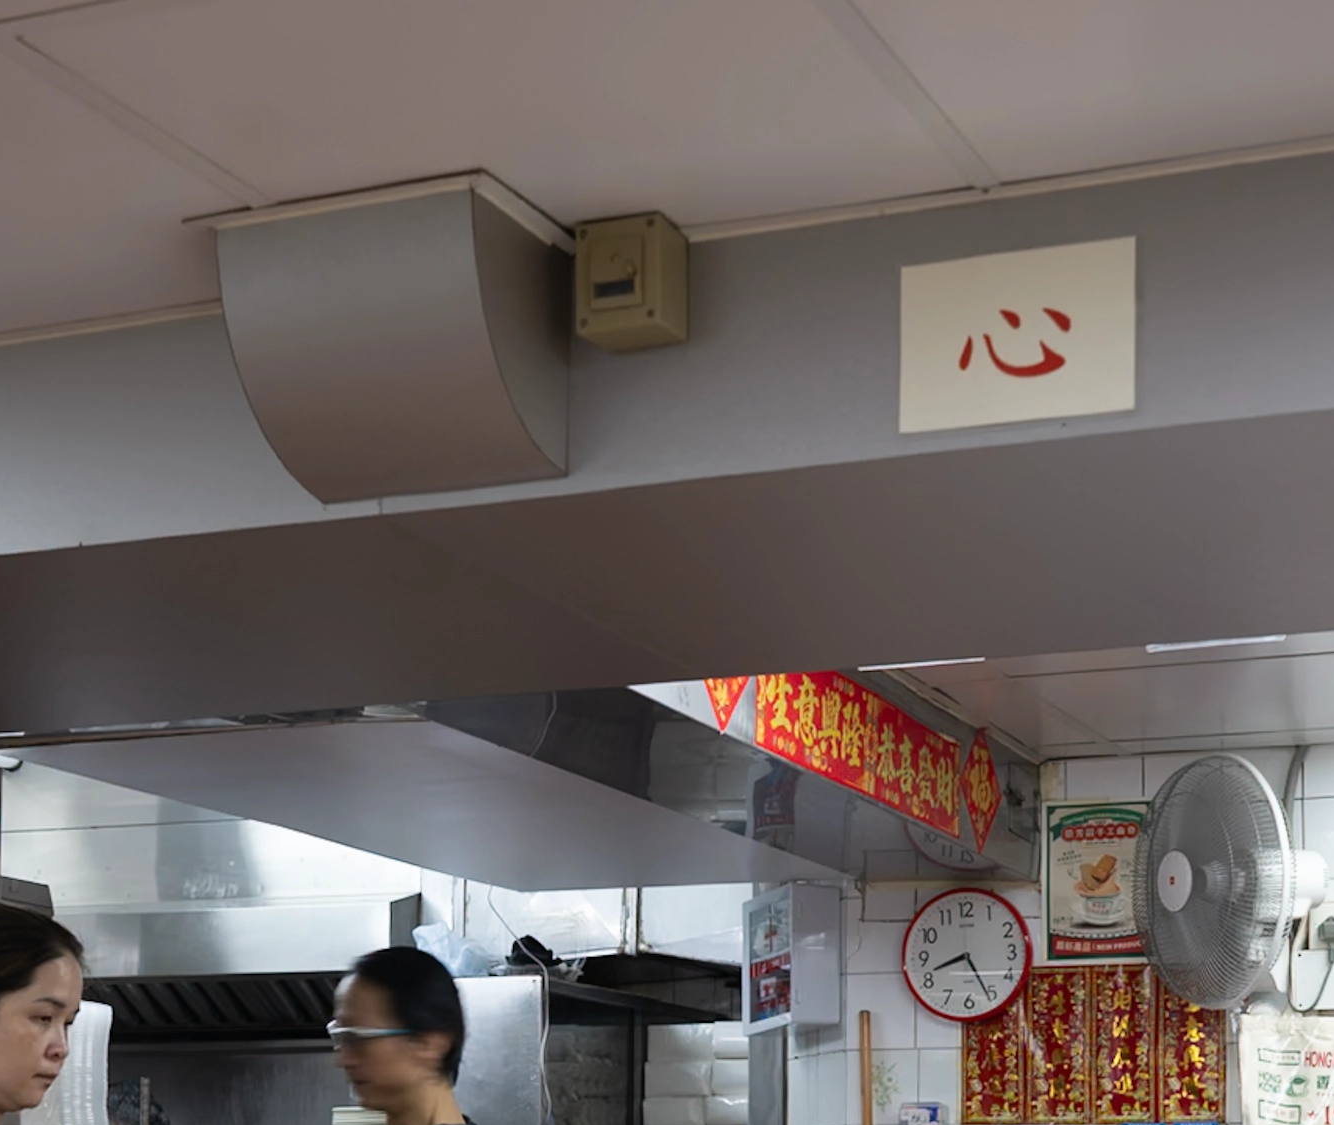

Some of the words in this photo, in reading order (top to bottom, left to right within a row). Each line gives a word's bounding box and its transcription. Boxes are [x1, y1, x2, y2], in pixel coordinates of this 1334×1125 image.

[957, 306, 1073, 378] 心
[876, 723, 954, 816] 恭喜發財
[940, 908, 952, 926] 11
[958, 901, 974, 918] 12
[922, 927, 937, 944] 10
[1002, 921, 1014, 939] 2
[919, 950, 929, 967] 9
[1007, 943, 1017, 961] 3
[923, 972, 934, 989] 8
[1003, 967, 1014, 982] 4
[943, 989, 953, 1005] 7
[964, 993, 975, 1010] 6
[988, 985, 998, 1001] 5
